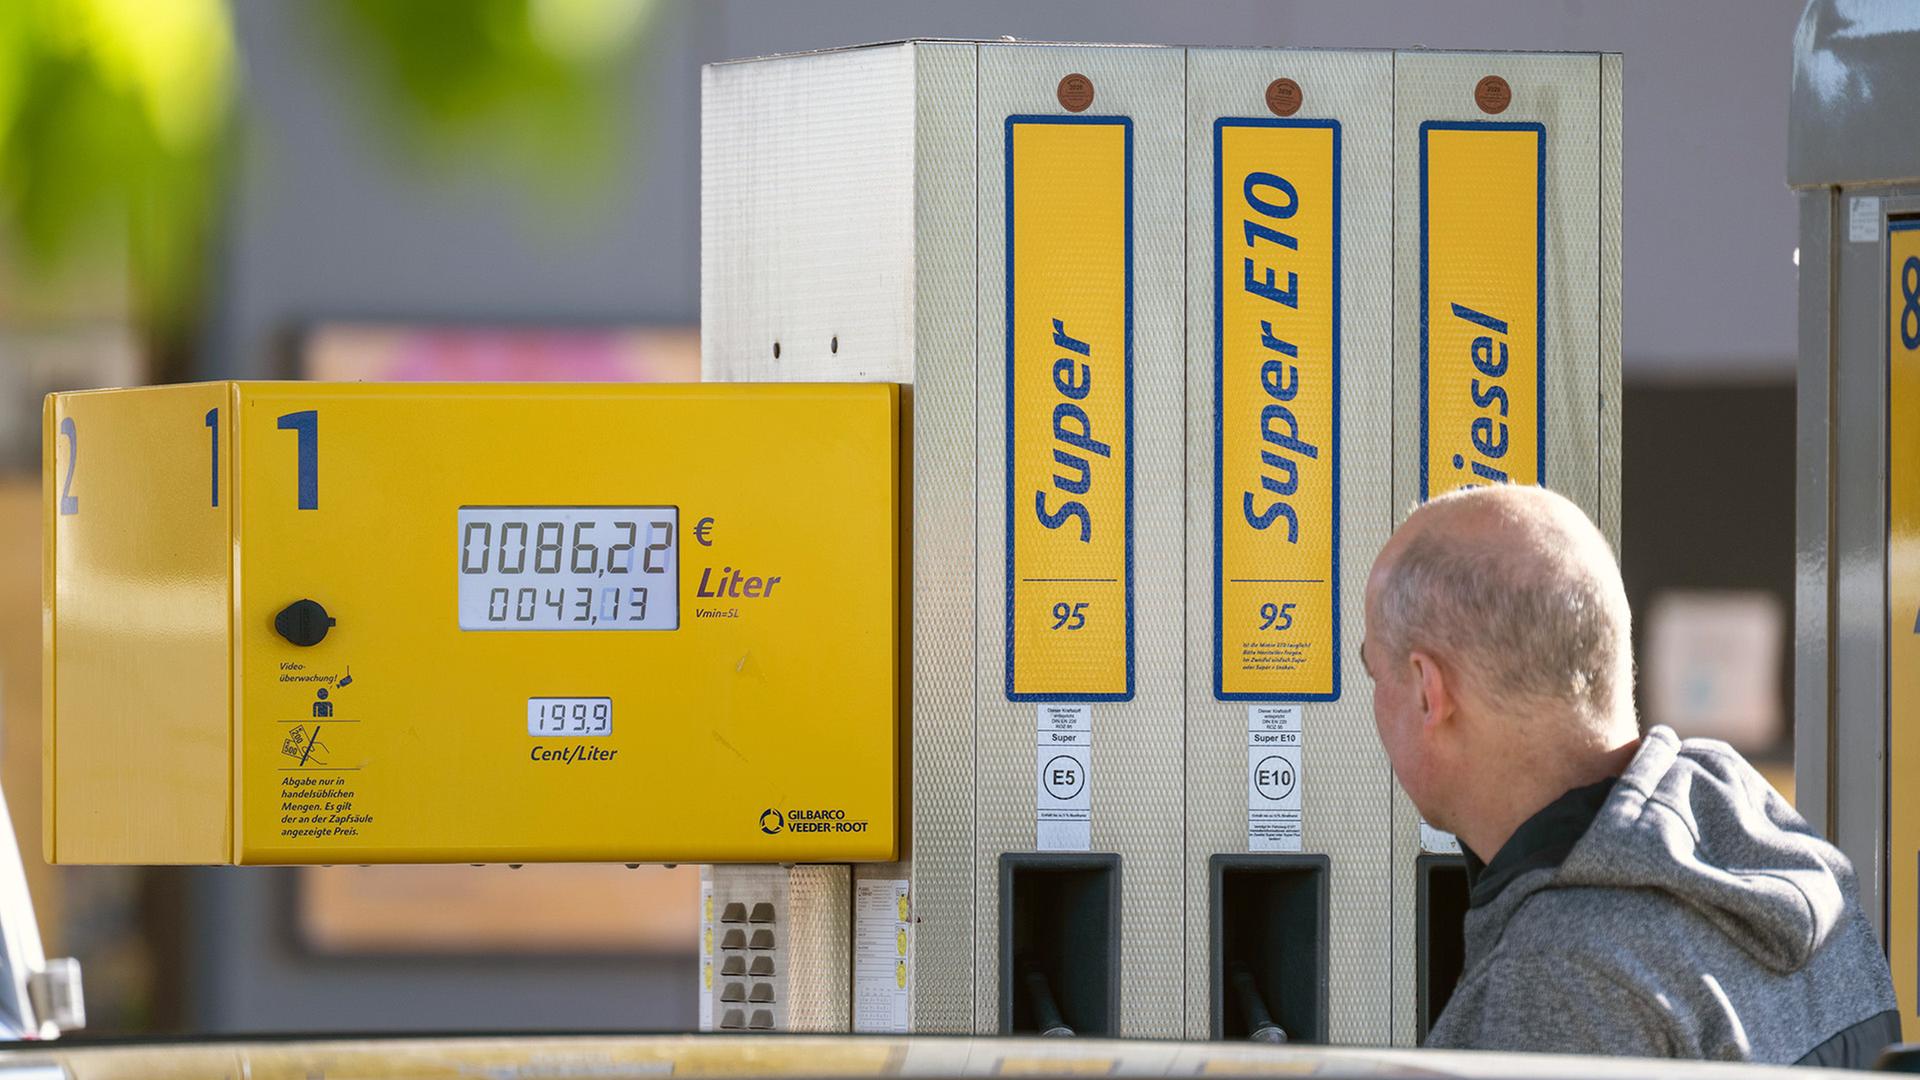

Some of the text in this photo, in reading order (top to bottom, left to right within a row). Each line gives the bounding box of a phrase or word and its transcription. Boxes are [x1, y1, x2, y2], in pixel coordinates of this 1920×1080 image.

[1243, 171, 1300, 310] E10
[1901, 256, 1920, 350] 8
[1450, 301, 1511, 490] iesel
[1035, 317, 1112, 543] Super
[1243, 320, 1319, 544] Super
[60, 416, 79, 516] 2
[205, 407, 219, 507] 1
[277, 410, 318, 510] 1
[693, 517, 715, 547] €
[461, 521, 673, 578] 0086,22
[696, 566, 782, 598] Liter
[488, 587, 648, 625] 0043,13
[696, 608, 740, 618] Vmin=5L
[1051, 602, 1089, 630] 95
[1259, 602, 1297, 631] 95
[280, 674, 338, 684] überwachung!
[540, 704, 607, 734] 199,9
[1052, 733, 1076, 743] Super
[1254, 734, 1296, 743] Super E10
[531, 745, 617, 765] Cent/Liter
[282, 777, 317, 788] Abgabe
[336, 777, 345, 785] in
[1053, 770, 1075, 785] E5
[1258, 770, 1291, 786] E10
[281, 789, 354, 798] handelsüblichen
[281, 802, 352, 813] Mengen. Es gilt
[281, 814, 297, 823] der
[311, 814, 327, 823] der
[329, 814, 373, 825] Zapfsäule
[788, 810, 845, 820] GILBARCO
[788, 822, 868, 833] VEEDER-ROOT
[281, 827, 359, 838] angezeigte Preis.
